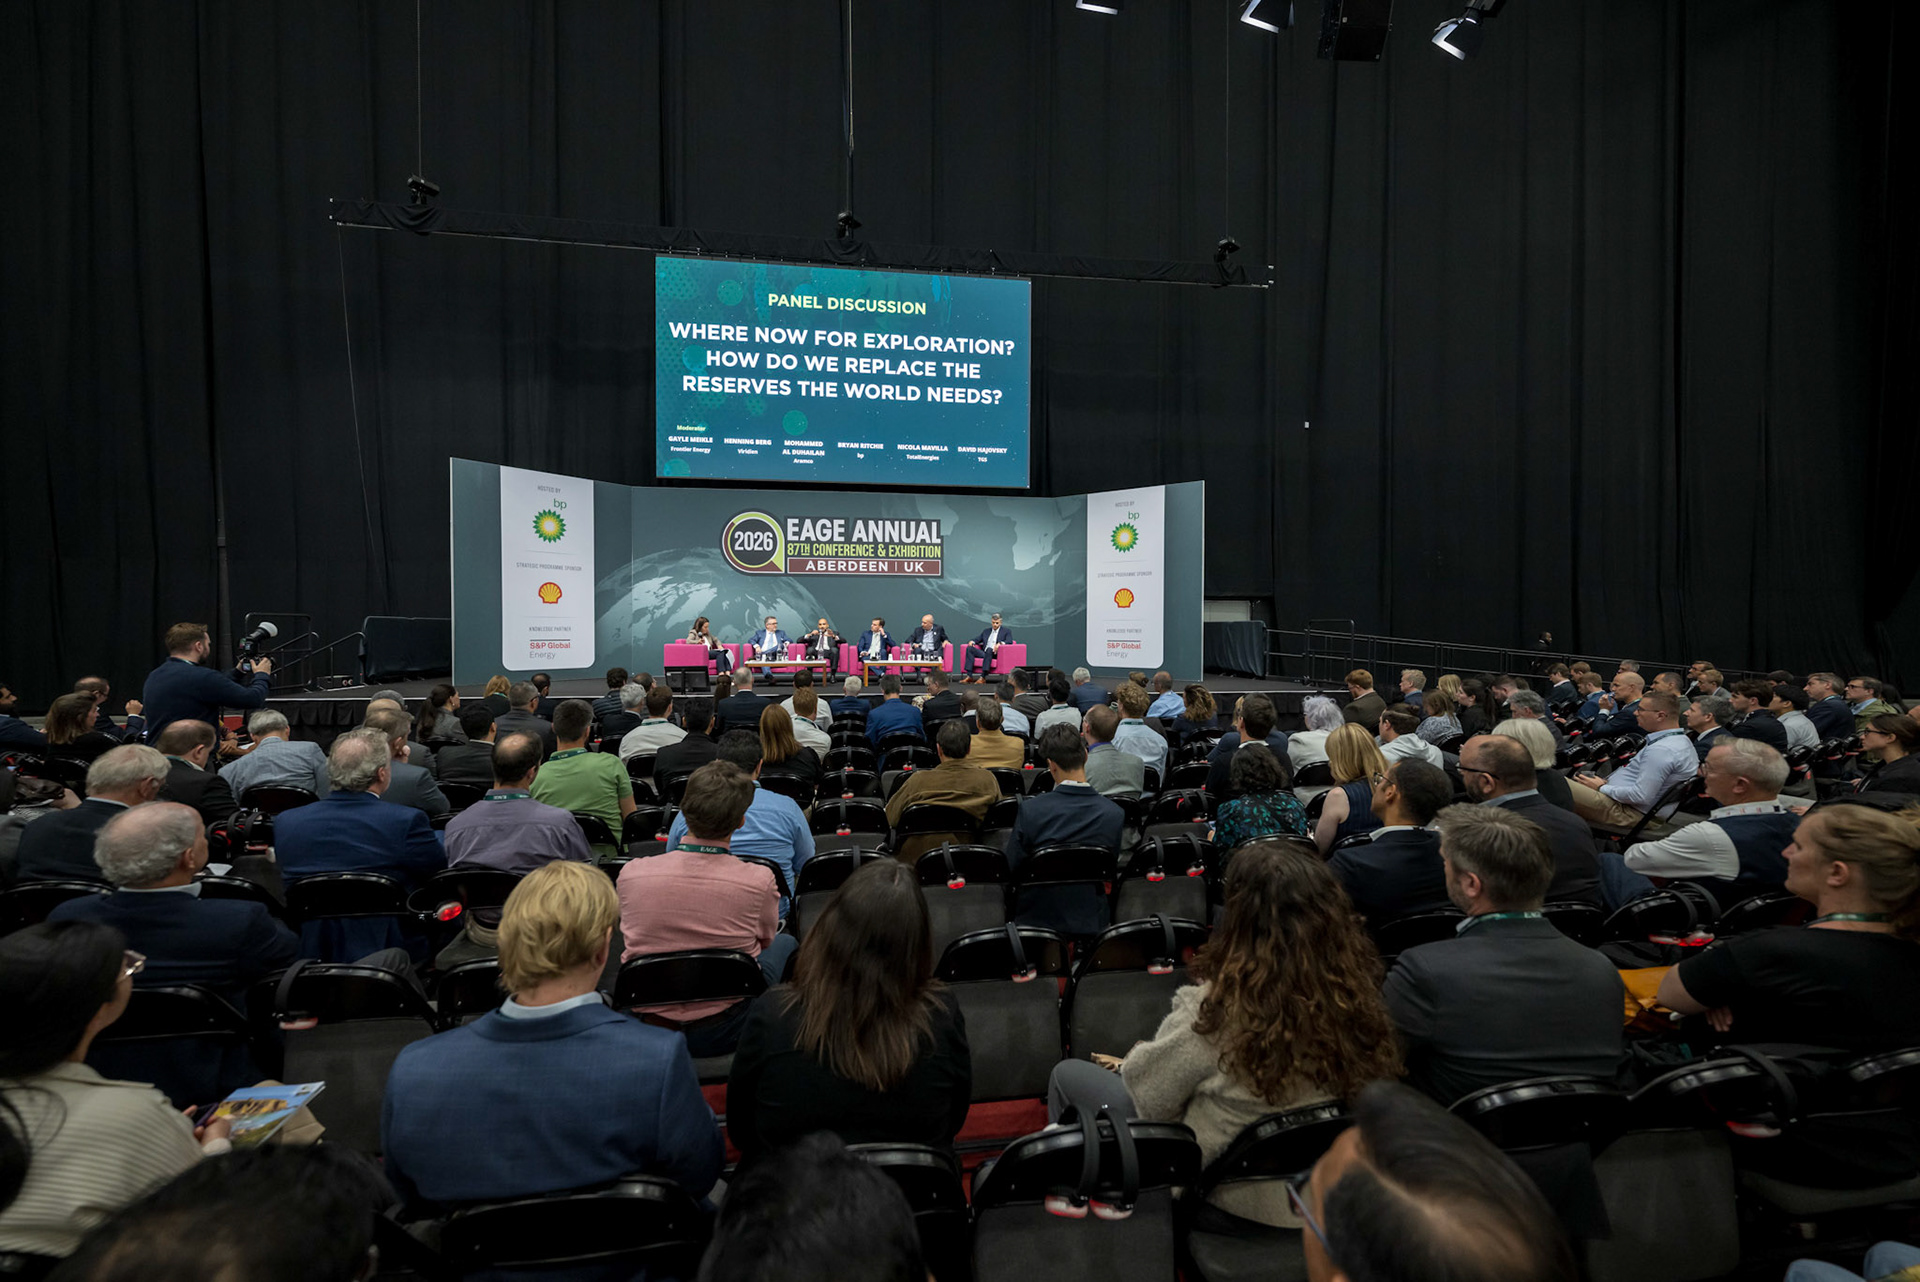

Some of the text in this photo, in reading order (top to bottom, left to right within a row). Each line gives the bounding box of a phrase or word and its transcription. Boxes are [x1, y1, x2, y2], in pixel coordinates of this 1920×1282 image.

[768, 293, 926, 315] PANEL DISCUSSION
[669, 322, 1015, 356] WHERE NOW FOR EXPLORATION?
[706, 350, 981, 379] HOW DO WE REPLACE THE
[682, 375, 1003, 405] RESERVES THE WORLD NEEDS?
[676, 424, 706, 432] Moderator
[692, 446, 711, 454] Energy
[921, 444, 948, 452] MAVILLA
[537, 485, 554, 493] HOSTED
[553, 498, 567, 510] bp
[1128, 511, 1140, 521] bp
[787, 518, 941, 544] EAGE ANNUAL
[734, 531, 774, 551] 2026
[787, 543, 941, 558] 87TH CONFERENCE & EXHIBITION
[805, 559, 925, 573] ABERDEEN UK
[529, 651, 556, 660] Energy
[1106, 651, 1128, 659] Energy
